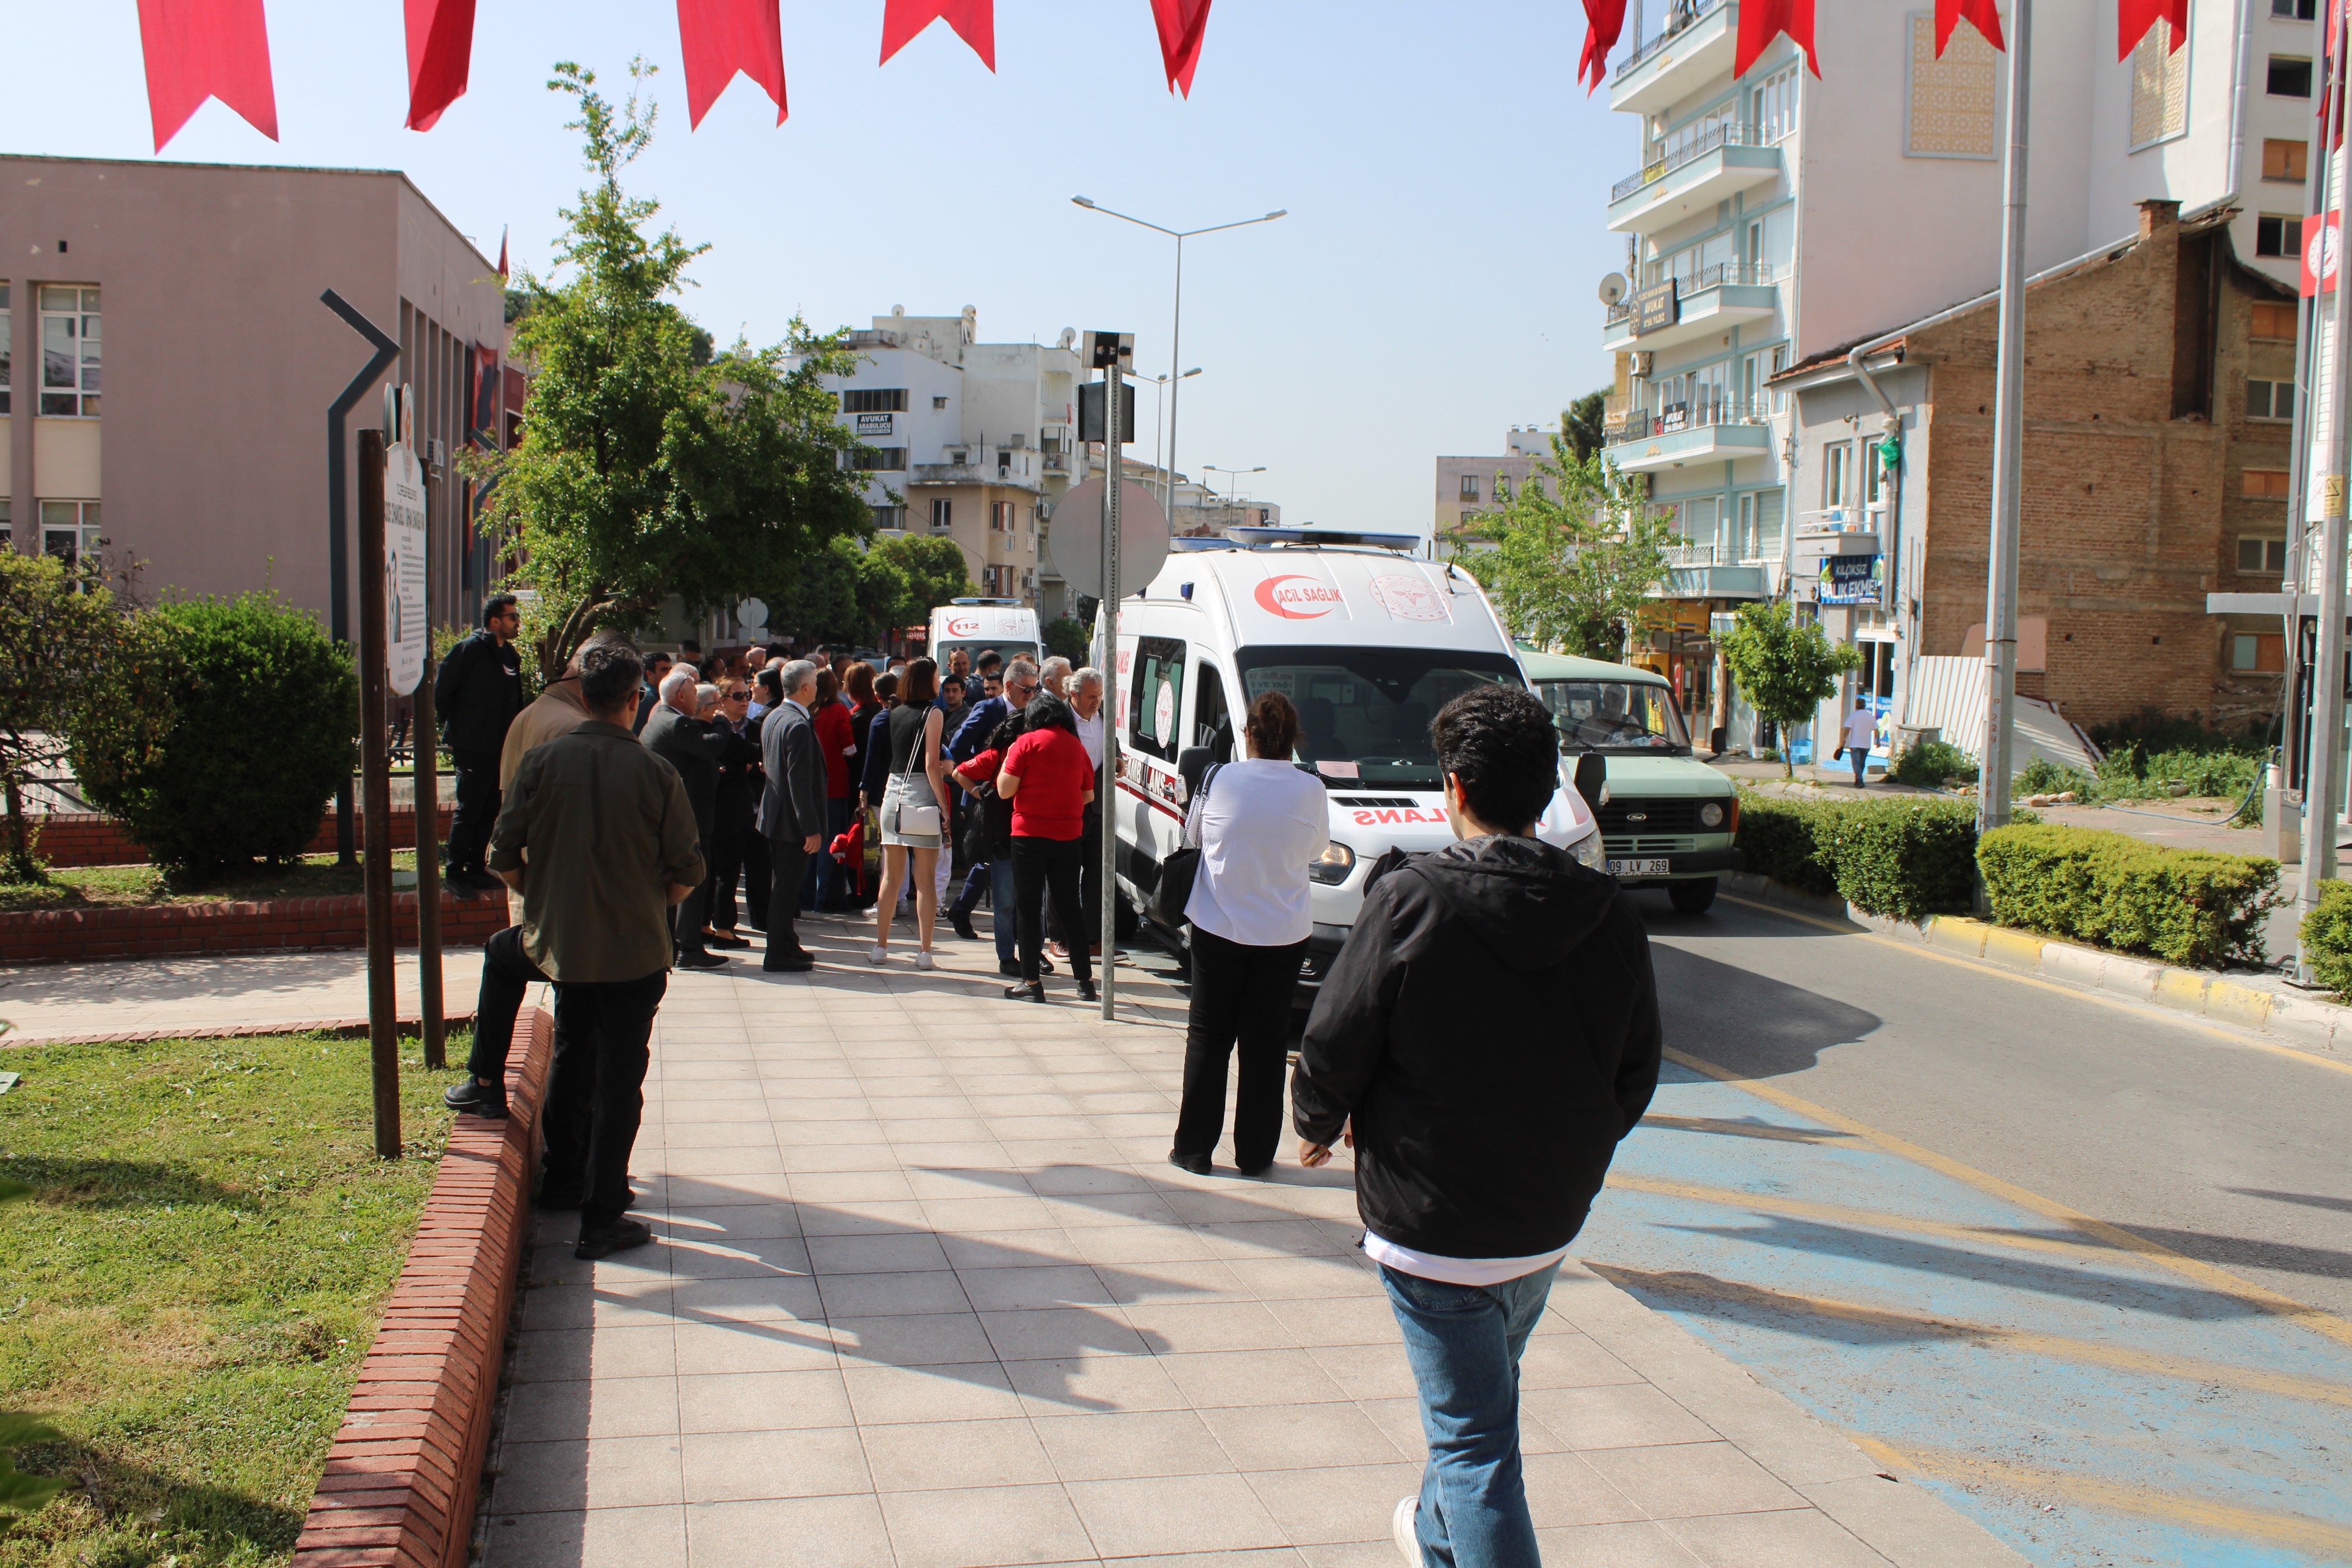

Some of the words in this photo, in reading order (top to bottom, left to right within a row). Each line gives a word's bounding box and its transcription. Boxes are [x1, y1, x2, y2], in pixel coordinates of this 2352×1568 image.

[1644, 296, 1664, 315] AVUKAT
[1665, 410, 1684, 424] AVUKAT
[1836, 564, 1867, 579] KILÇIKSIZ
[1303, 586, 1343, 602] SAĞLIK
[1820, 580, 1848, 598] BALIK
[1127, 759, 1166, 798] AMBULANS
[1610, 861, 1621, 872] 09
[1630, 861, 1641, 871] LV
[1650, 860, 1667, 871] 269
